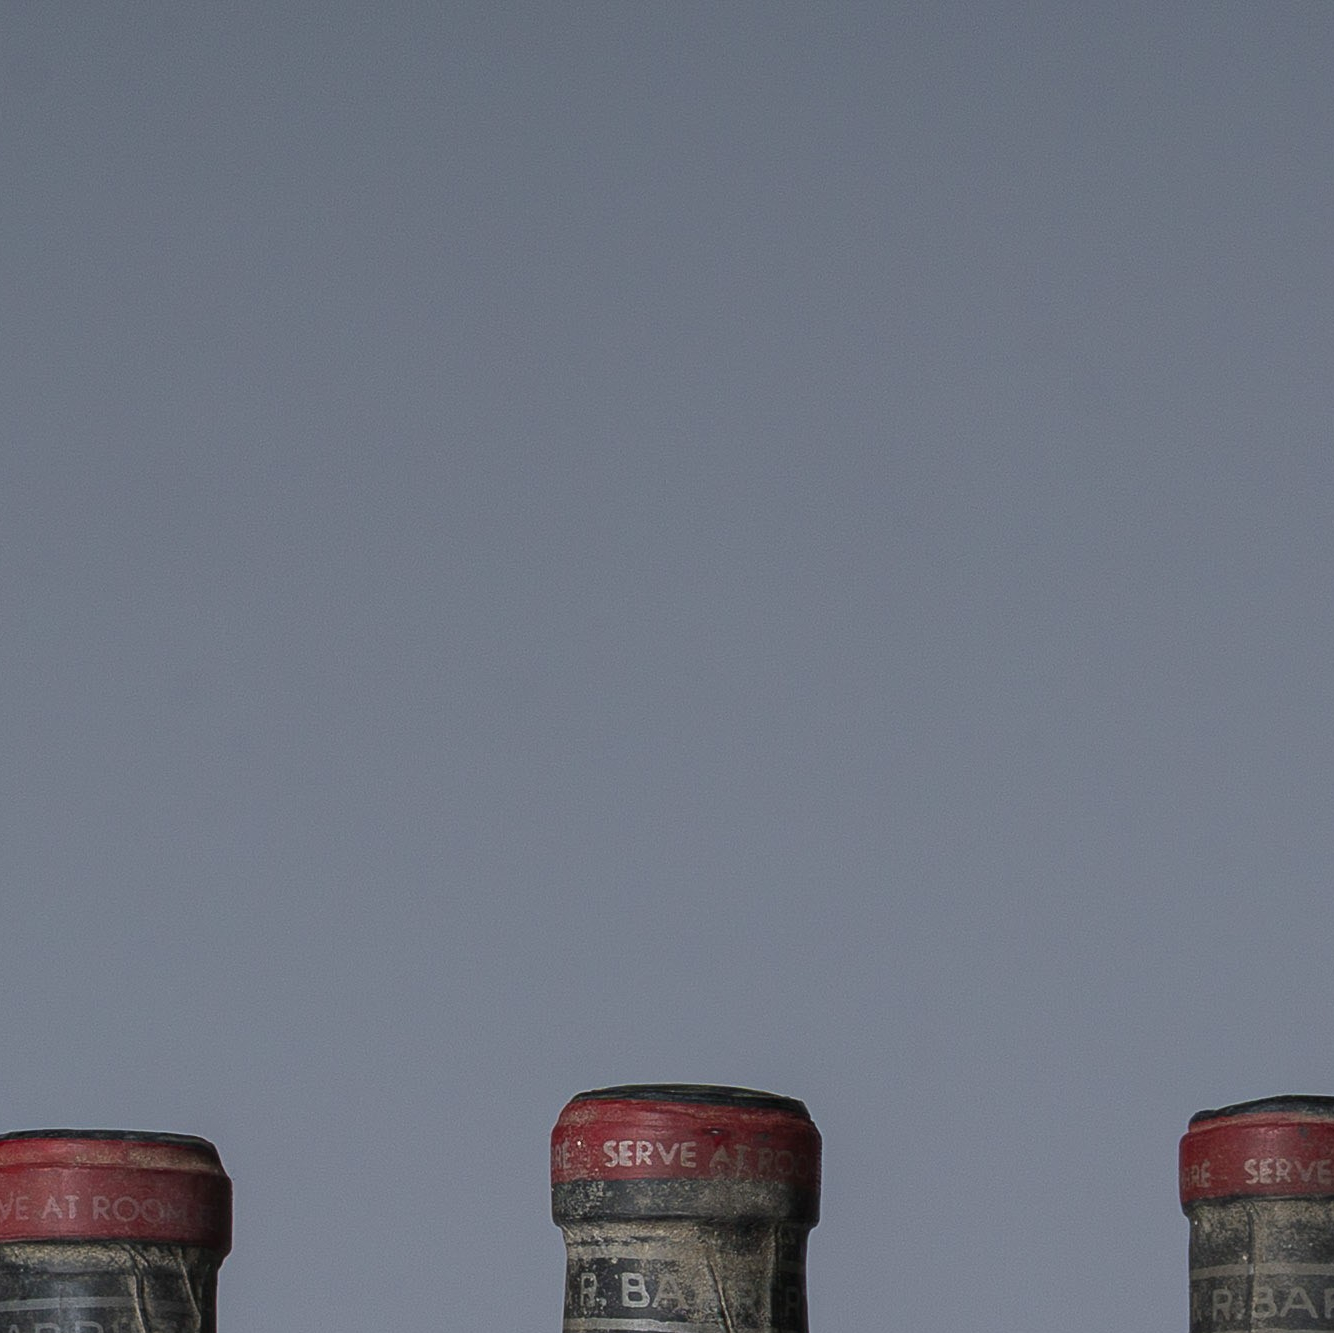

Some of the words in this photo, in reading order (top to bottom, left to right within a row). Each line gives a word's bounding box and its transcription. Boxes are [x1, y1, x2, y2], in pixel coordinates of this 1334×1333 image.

[602, 1140, 698, 1168] SERVE
[1243, 1157, 1333, 1186] SERVE
[40, 1196, 81, 1220] AT
